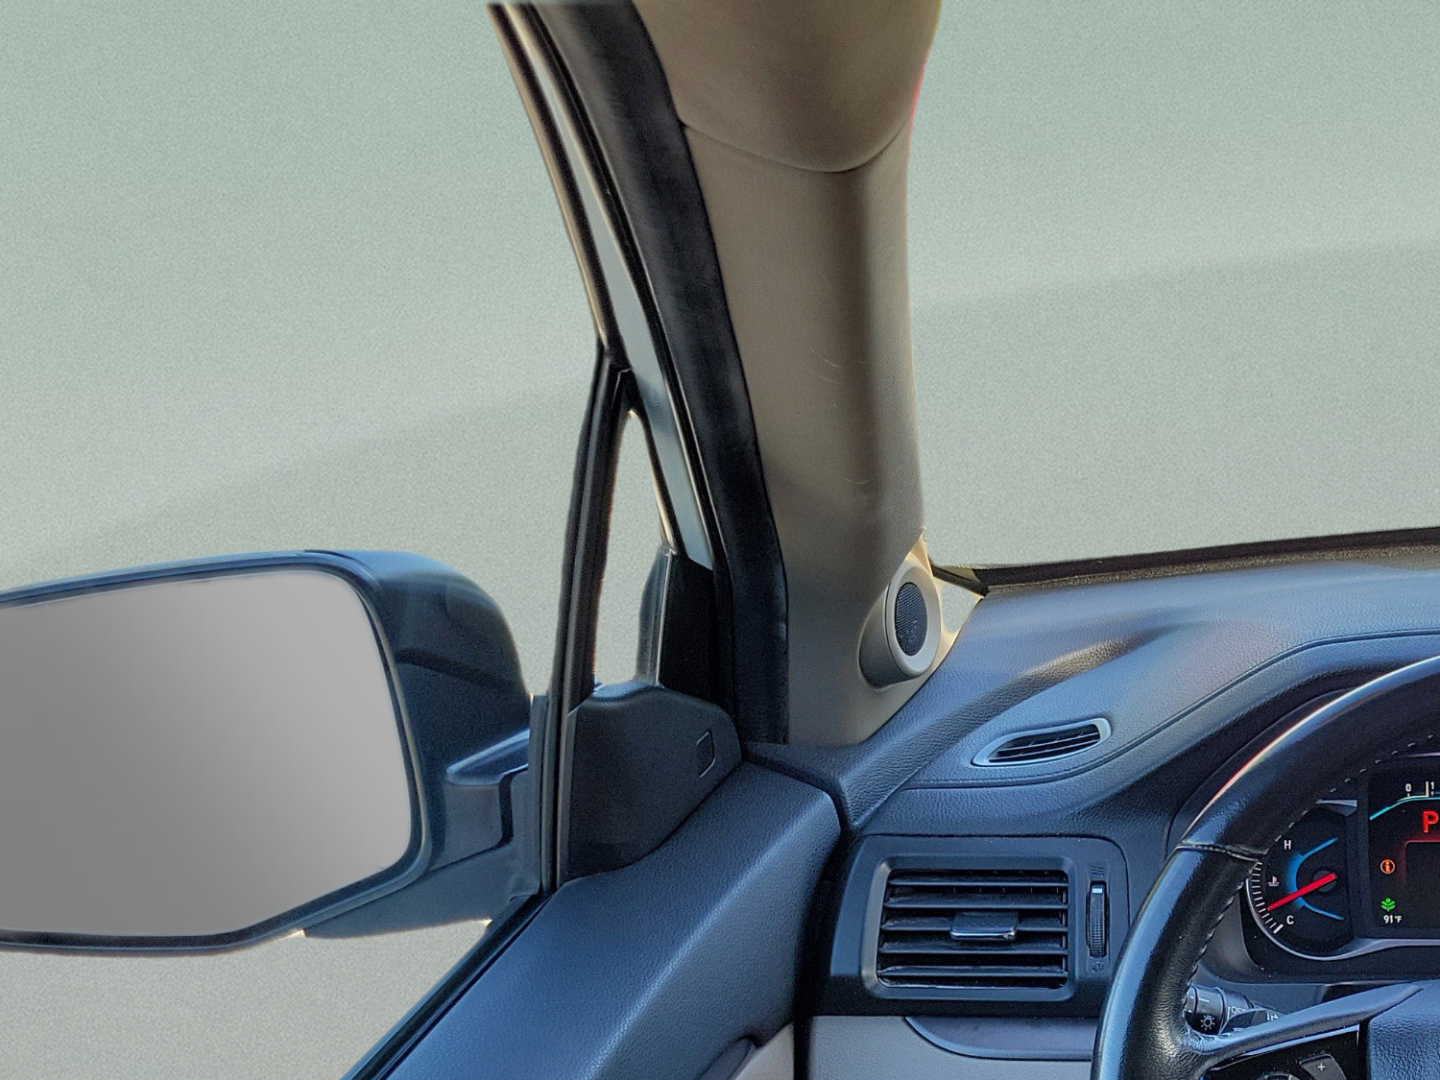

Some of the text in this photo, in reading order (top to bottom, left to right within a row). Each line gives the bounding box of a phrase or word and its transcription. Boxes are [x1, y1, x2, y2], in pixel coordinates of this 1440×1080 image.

[1405, 784, 1412, 792] 0
[1422, 810, 1439, 833] P
[1283, 839, 1292, 850] H
[1286, 915, 1295, 925] C
